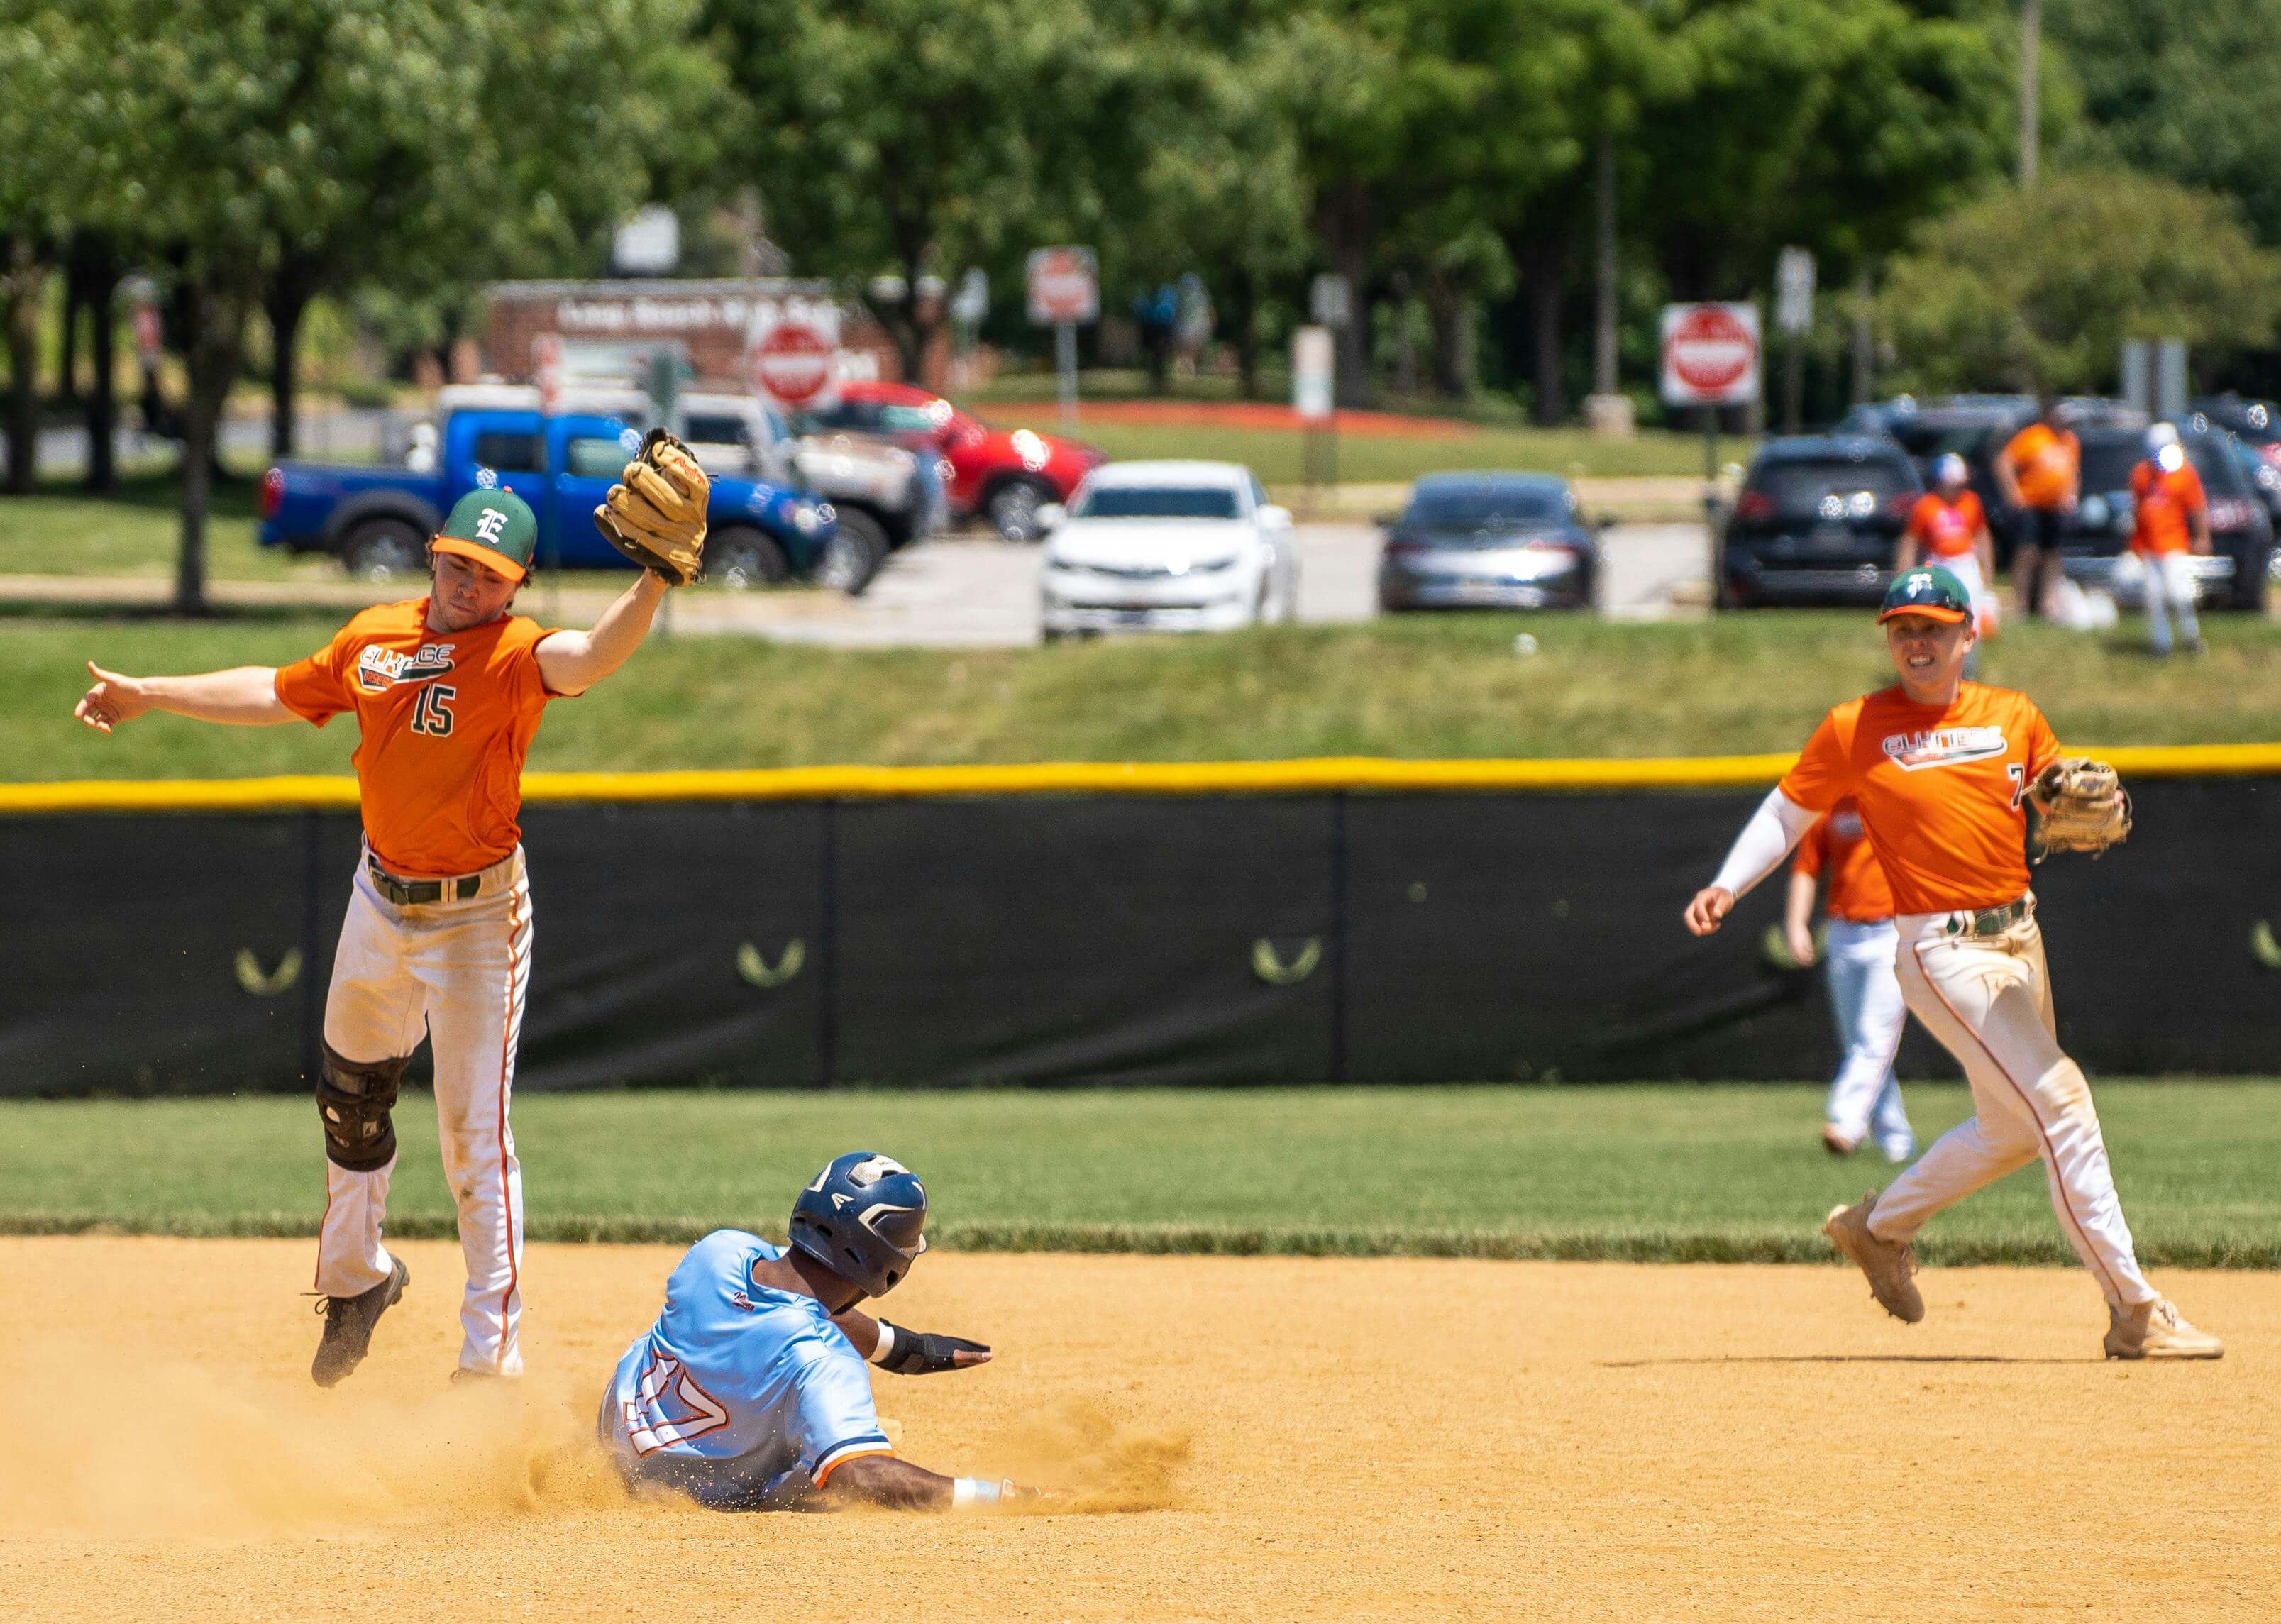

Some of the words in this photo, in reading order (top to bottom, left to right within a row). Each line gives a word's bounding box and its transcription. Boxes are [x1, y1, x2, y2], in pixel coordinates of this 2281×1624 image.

[475, 507, 509, 544] E
[410, 682, 456, 737] 15
[2006, 762, 2025, 812] 7
